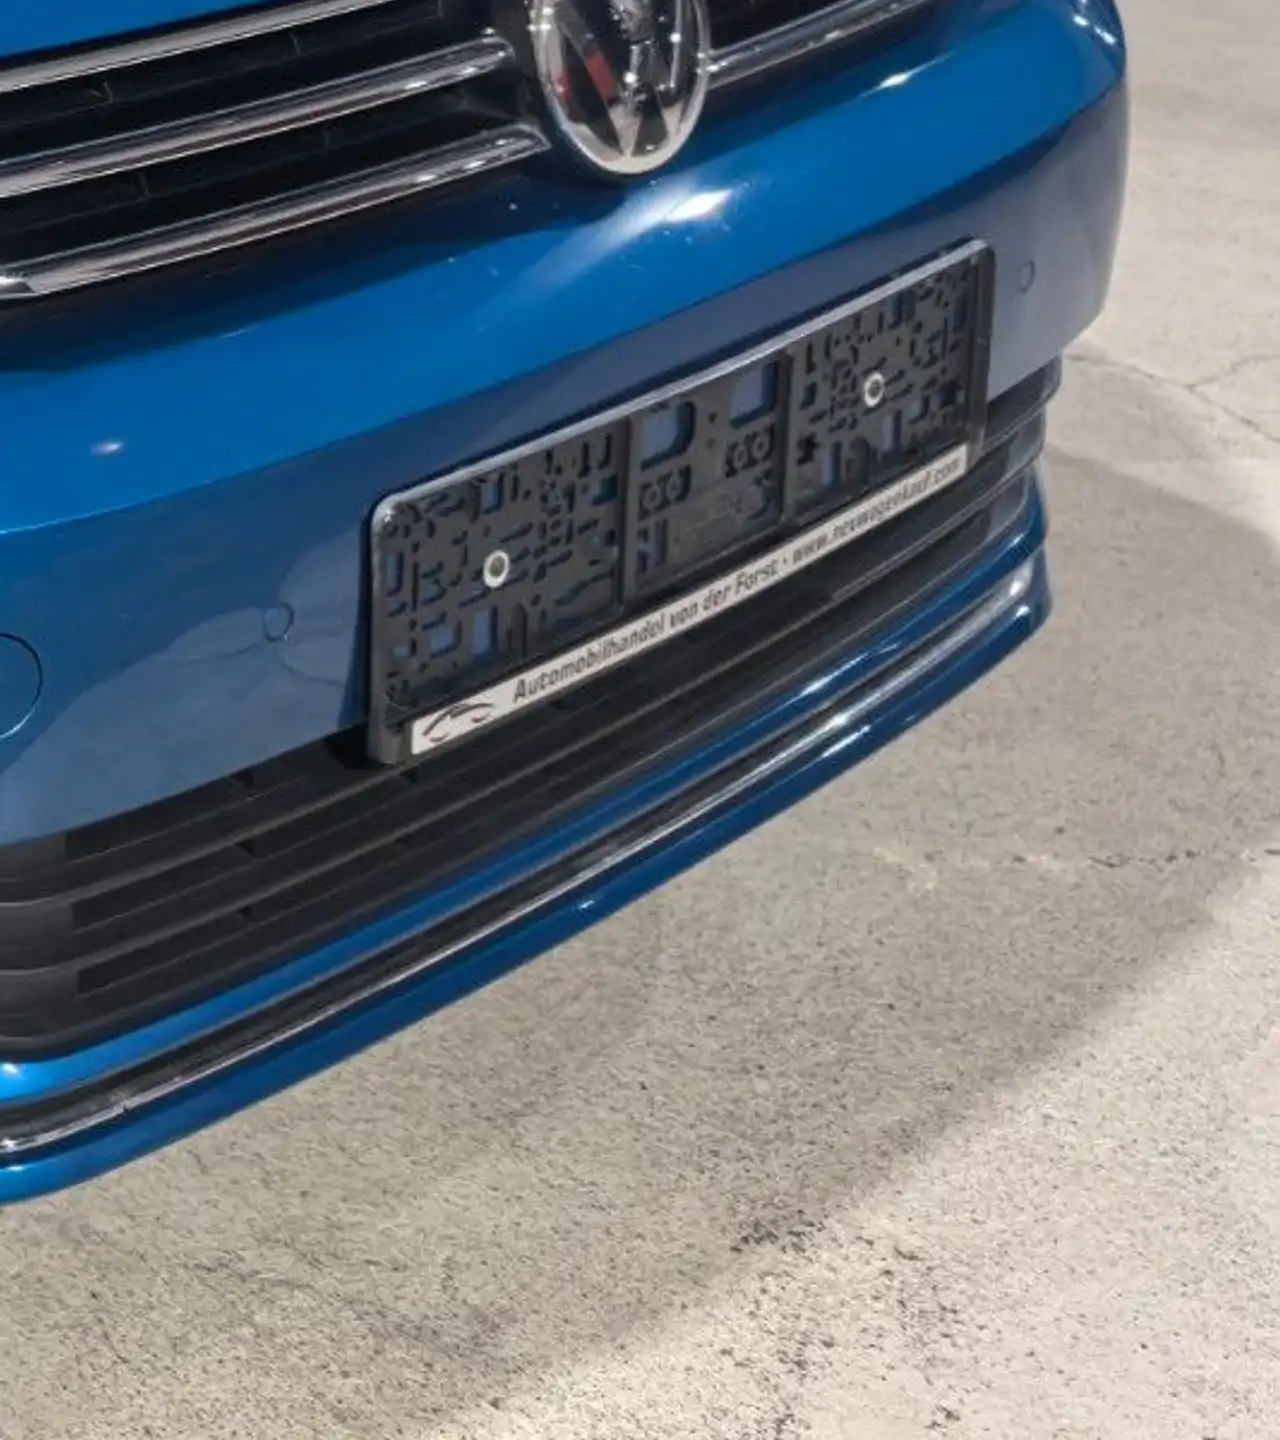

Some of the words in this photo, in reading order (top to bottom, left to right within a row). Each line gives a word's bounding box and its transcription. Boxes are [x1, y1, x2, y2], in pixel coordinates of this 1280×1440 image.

[513, 613, 666, 703] Automobilhandel
[670, 602, 698, 628] von
[703, 585, 731, 610] der
[735, 559, 778, 594] Forst
